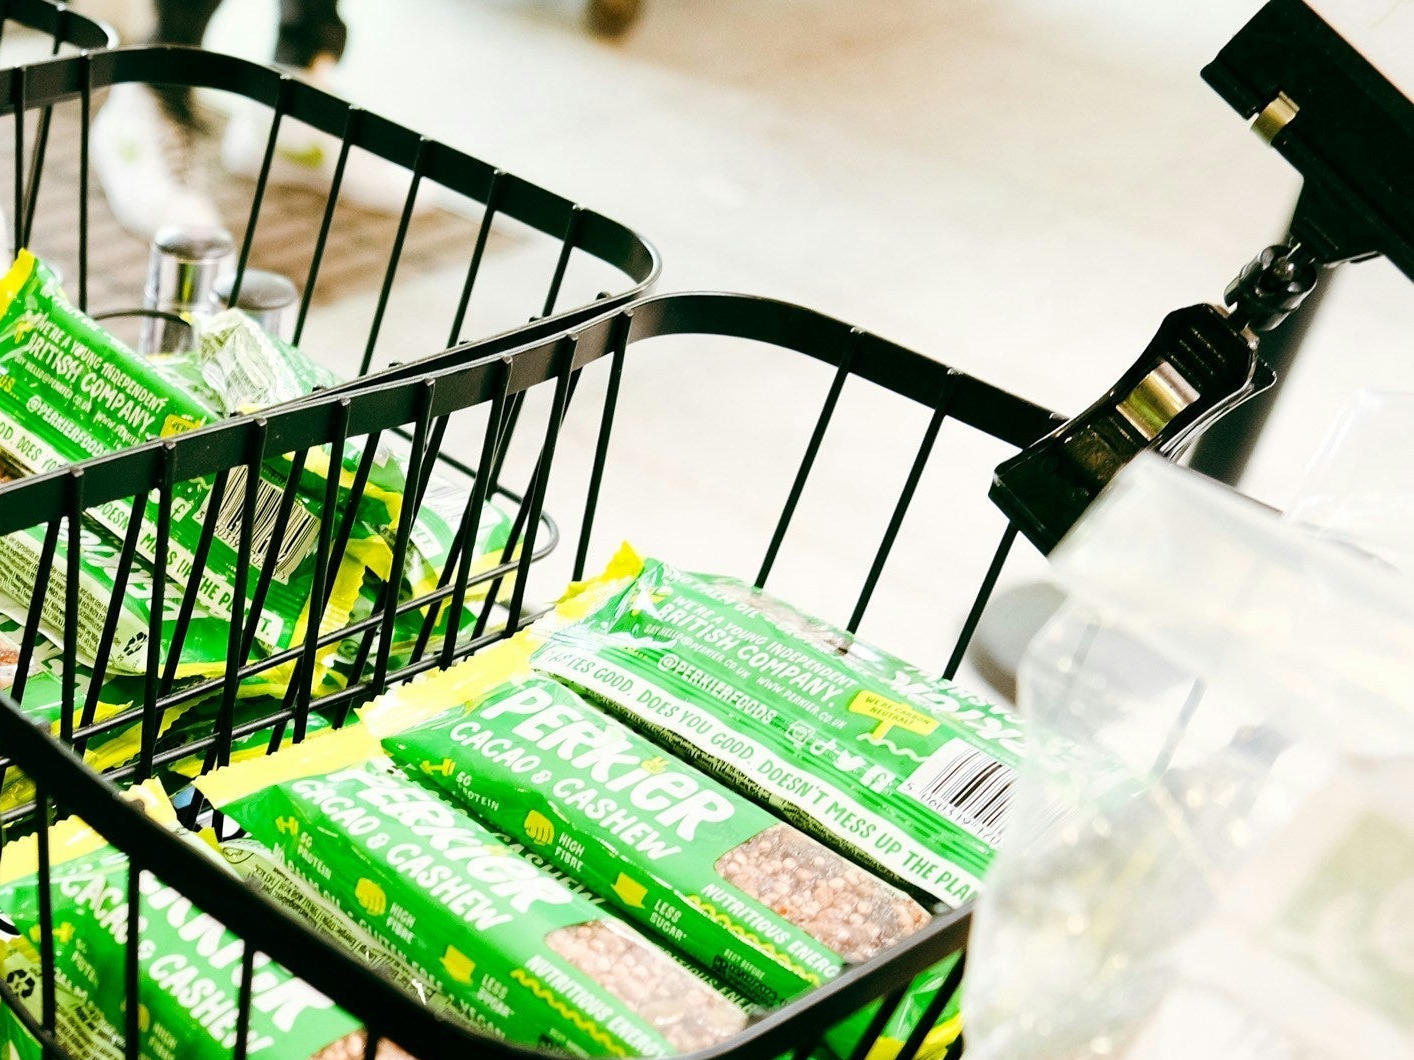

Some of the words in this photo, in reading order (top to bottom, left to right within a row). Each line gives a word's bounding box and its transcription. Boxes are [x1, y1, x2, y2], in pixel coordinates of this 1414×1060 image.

[16, 434, 43, 462] DOES
[656, 601, 741, 652] BRITISH
[723, 620, 771, 649] YOUNG
[765, 641, 860, 688] INDEPENDENT
[657, 652, 778, 726] @PERKIERFOODS
[449, 721, 540, 774] CACAO
[530, 766, 553, 784] &
[553, 778, 681, 861] CASHEW
[480, 687, 735, 842] PERKIER
[637, 688, 682, 719] DOES
[680, 708, 713, 736] YOU
[757, 758, 830, 807] DOESN'T
[824, 801, 878, 841] MESS
[875, 832, 904, 857] UP
[901, 849, 941, 881] THE
[292, 780, 381, 843] CACAO
[366, 832, 391, 850] &
[387, 843, 513, 931] CASHEW
[555, 847, 585, 873] FIBRE
[558, 833, 586, 857] HIGH
[653, 898, 682, 924] LESS
[700, 883, 791, 946] NUTRITIOUS
[787, 936, 842, 979] ENERG
[525, 955, 614, 1022] NUTRITIOUS
